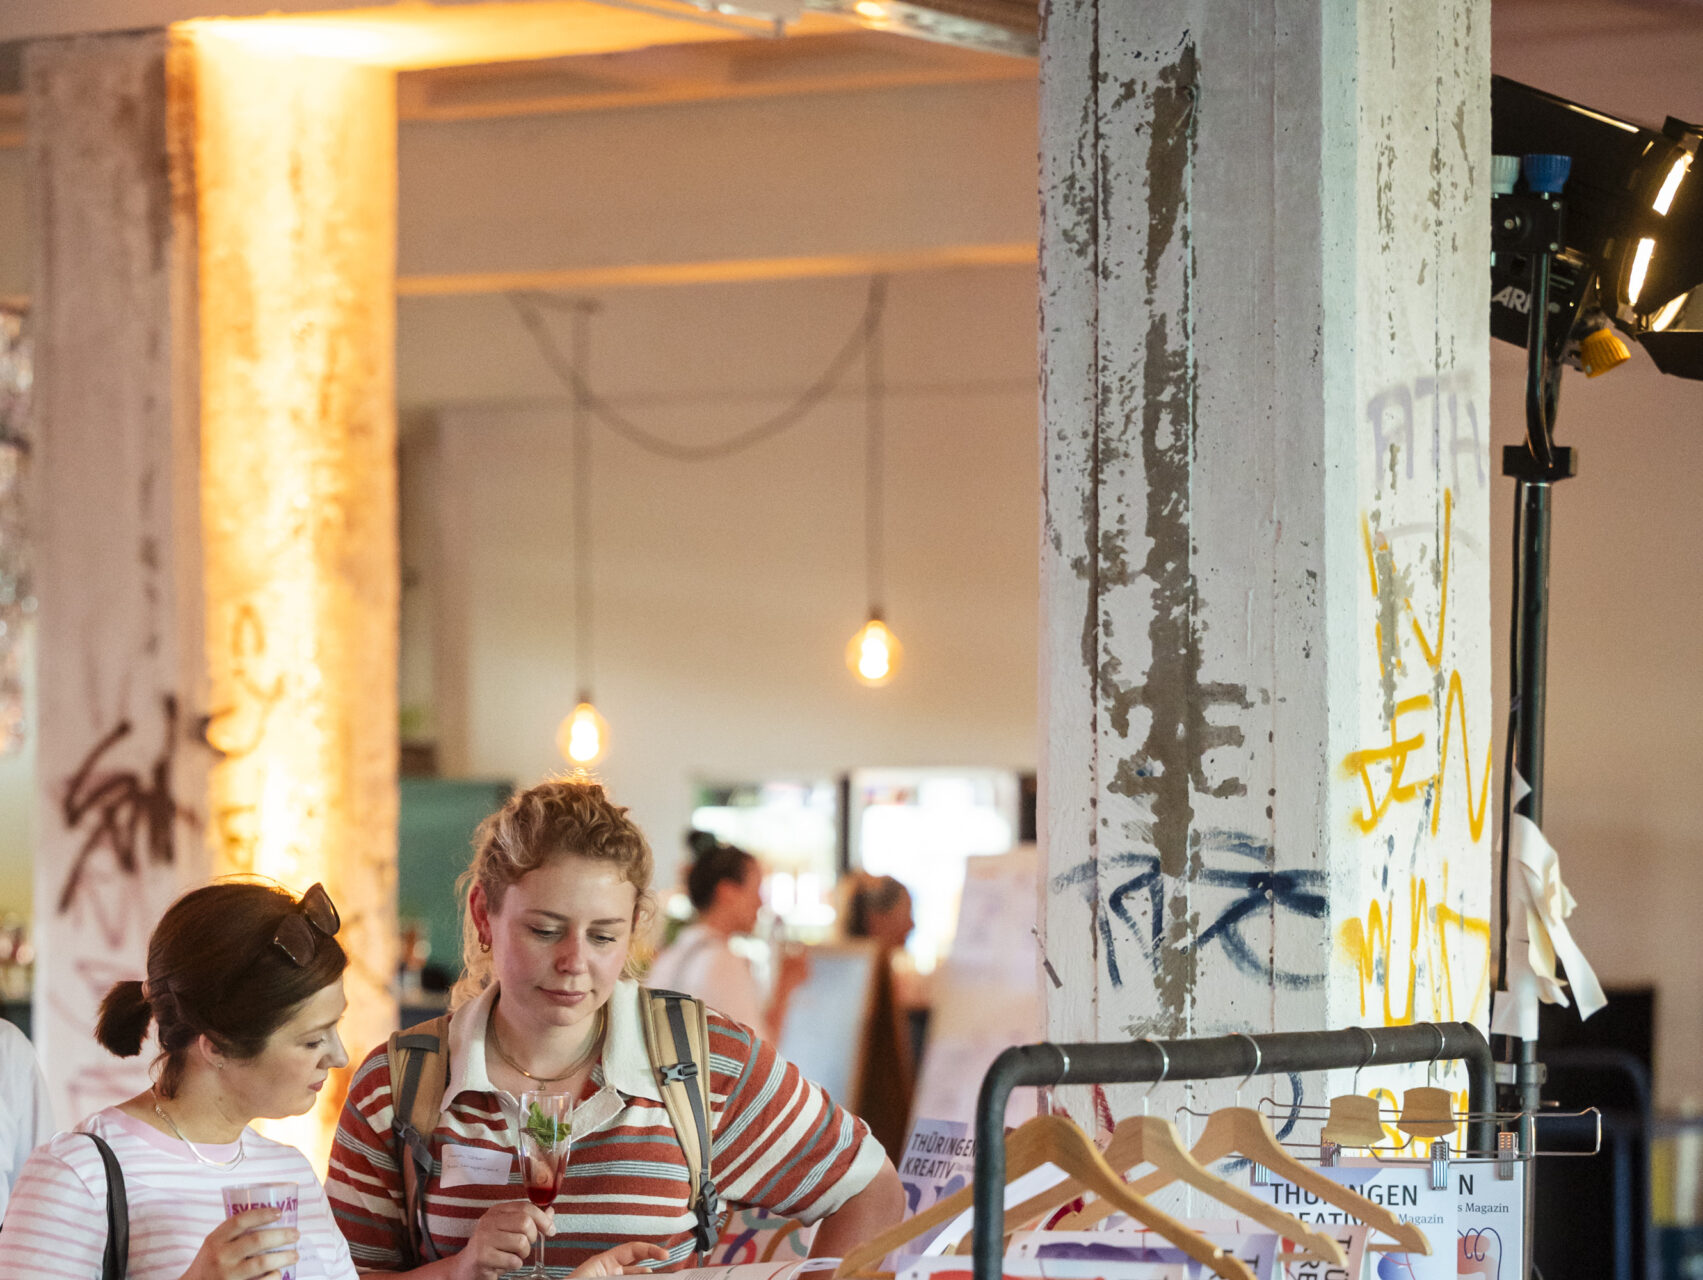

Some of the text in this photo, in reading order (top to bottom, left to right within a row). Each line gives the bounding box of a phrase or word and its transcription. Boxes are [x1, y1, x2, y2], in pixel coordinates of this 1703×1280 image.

[912, 1131, 977, 1158] THÜRINGEN
[903, 1157, 956, 1179] KREATIV
[1465, 1203, 1510, 1215] Magazin
[1398, 1213, 1444, 1225] Magazin
